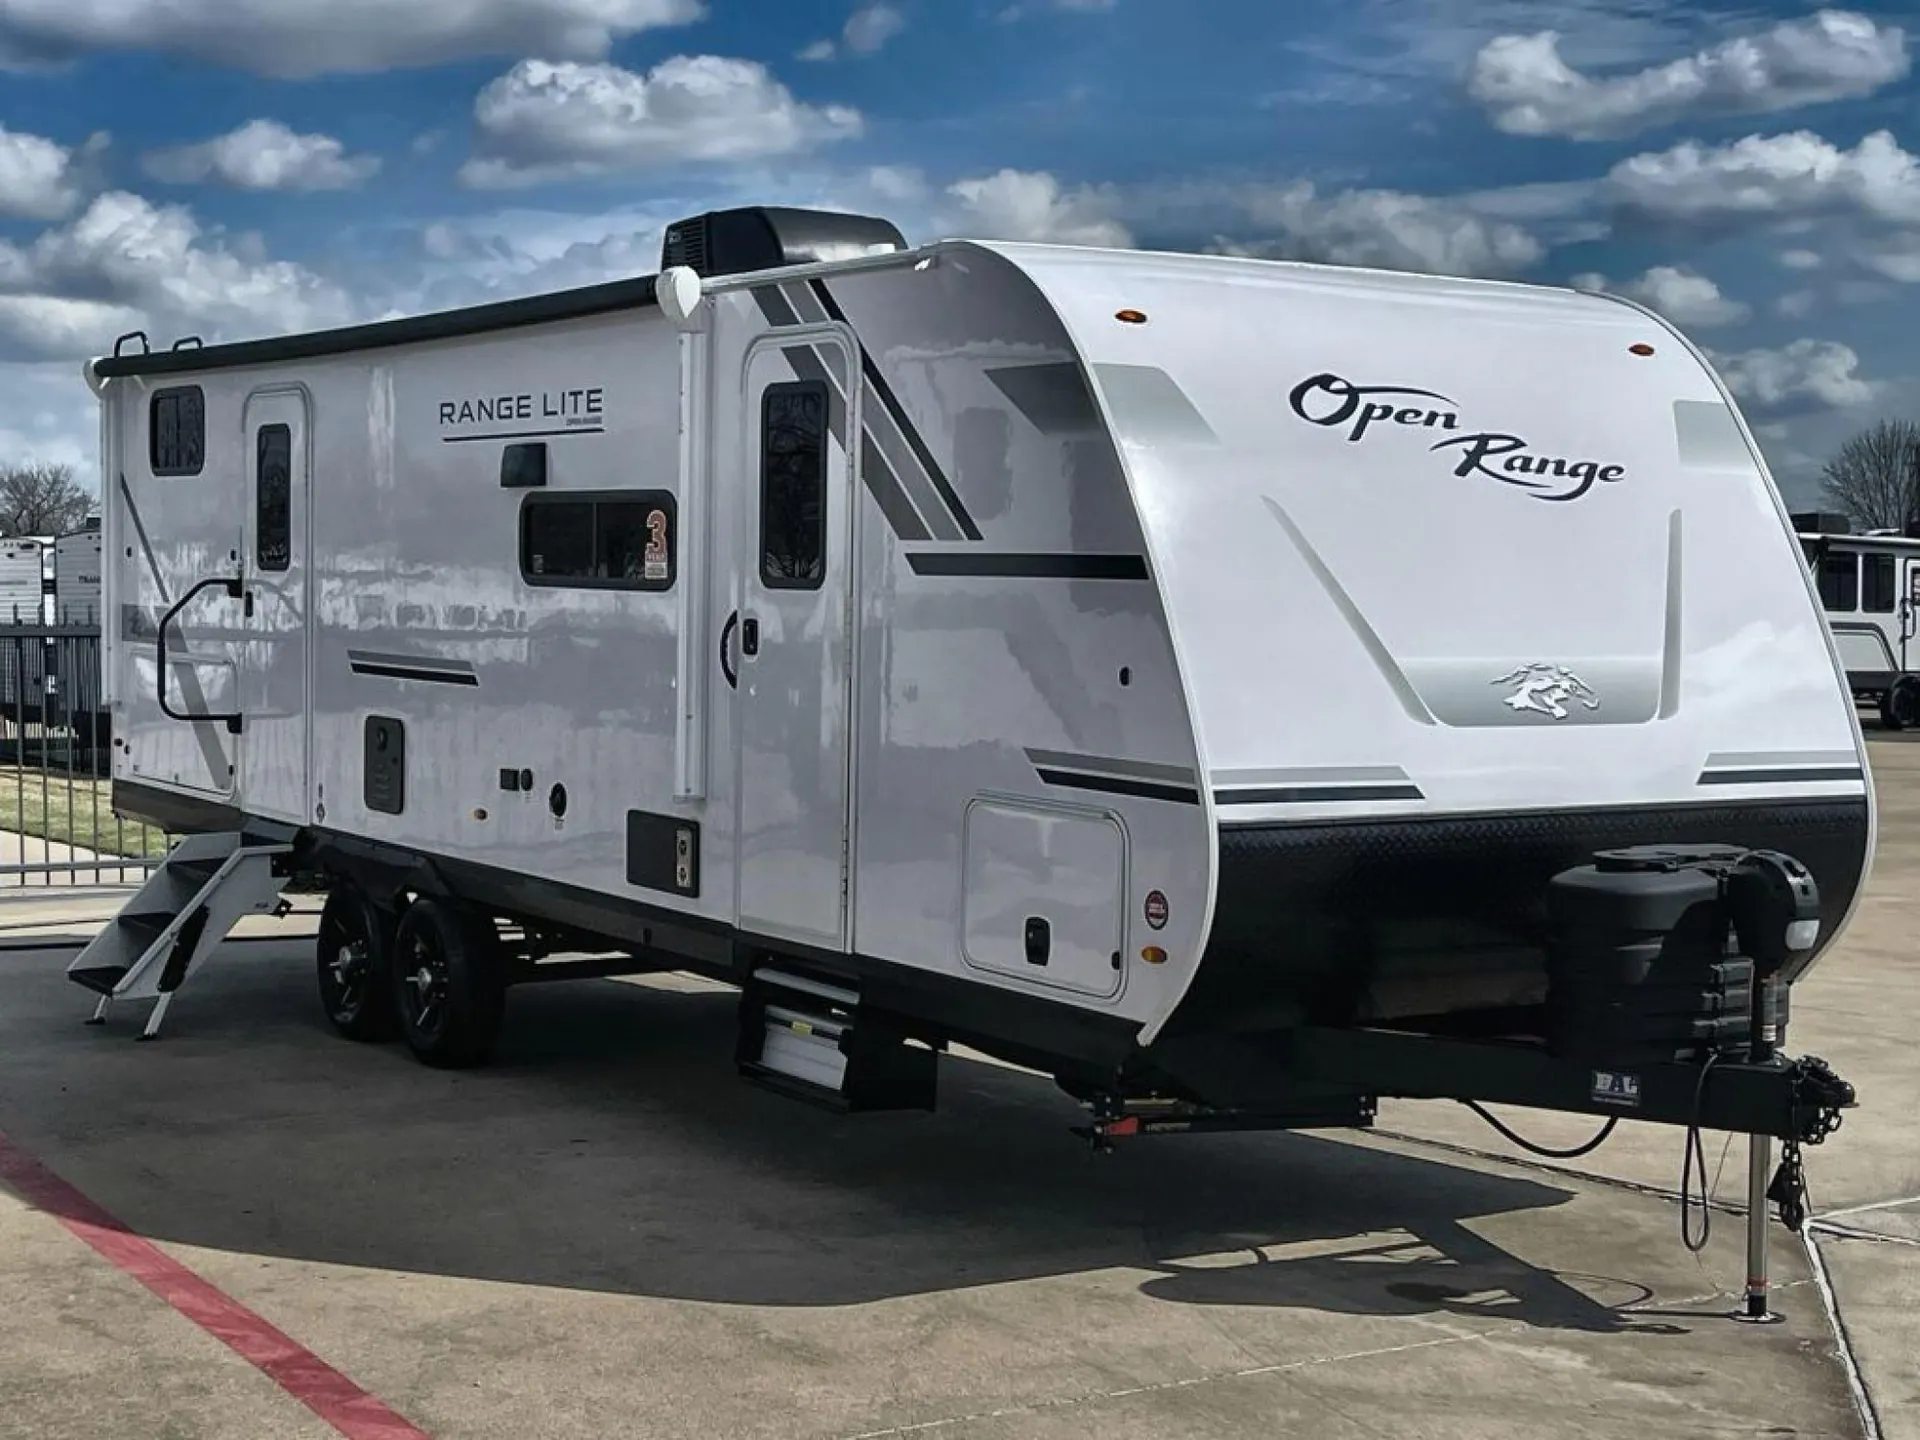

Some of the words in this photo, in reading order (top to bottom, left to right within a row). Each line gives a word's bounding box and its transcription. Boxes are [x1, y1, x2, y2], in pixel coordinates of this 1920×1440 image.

[440, 395, 531, 424] RANGE
[543, 388, 602, 416] LITE
[1289, 373, 1460, 441] Open
[1430, 433, 1625, 501] Range
[646, 510, 667, 553] 3
